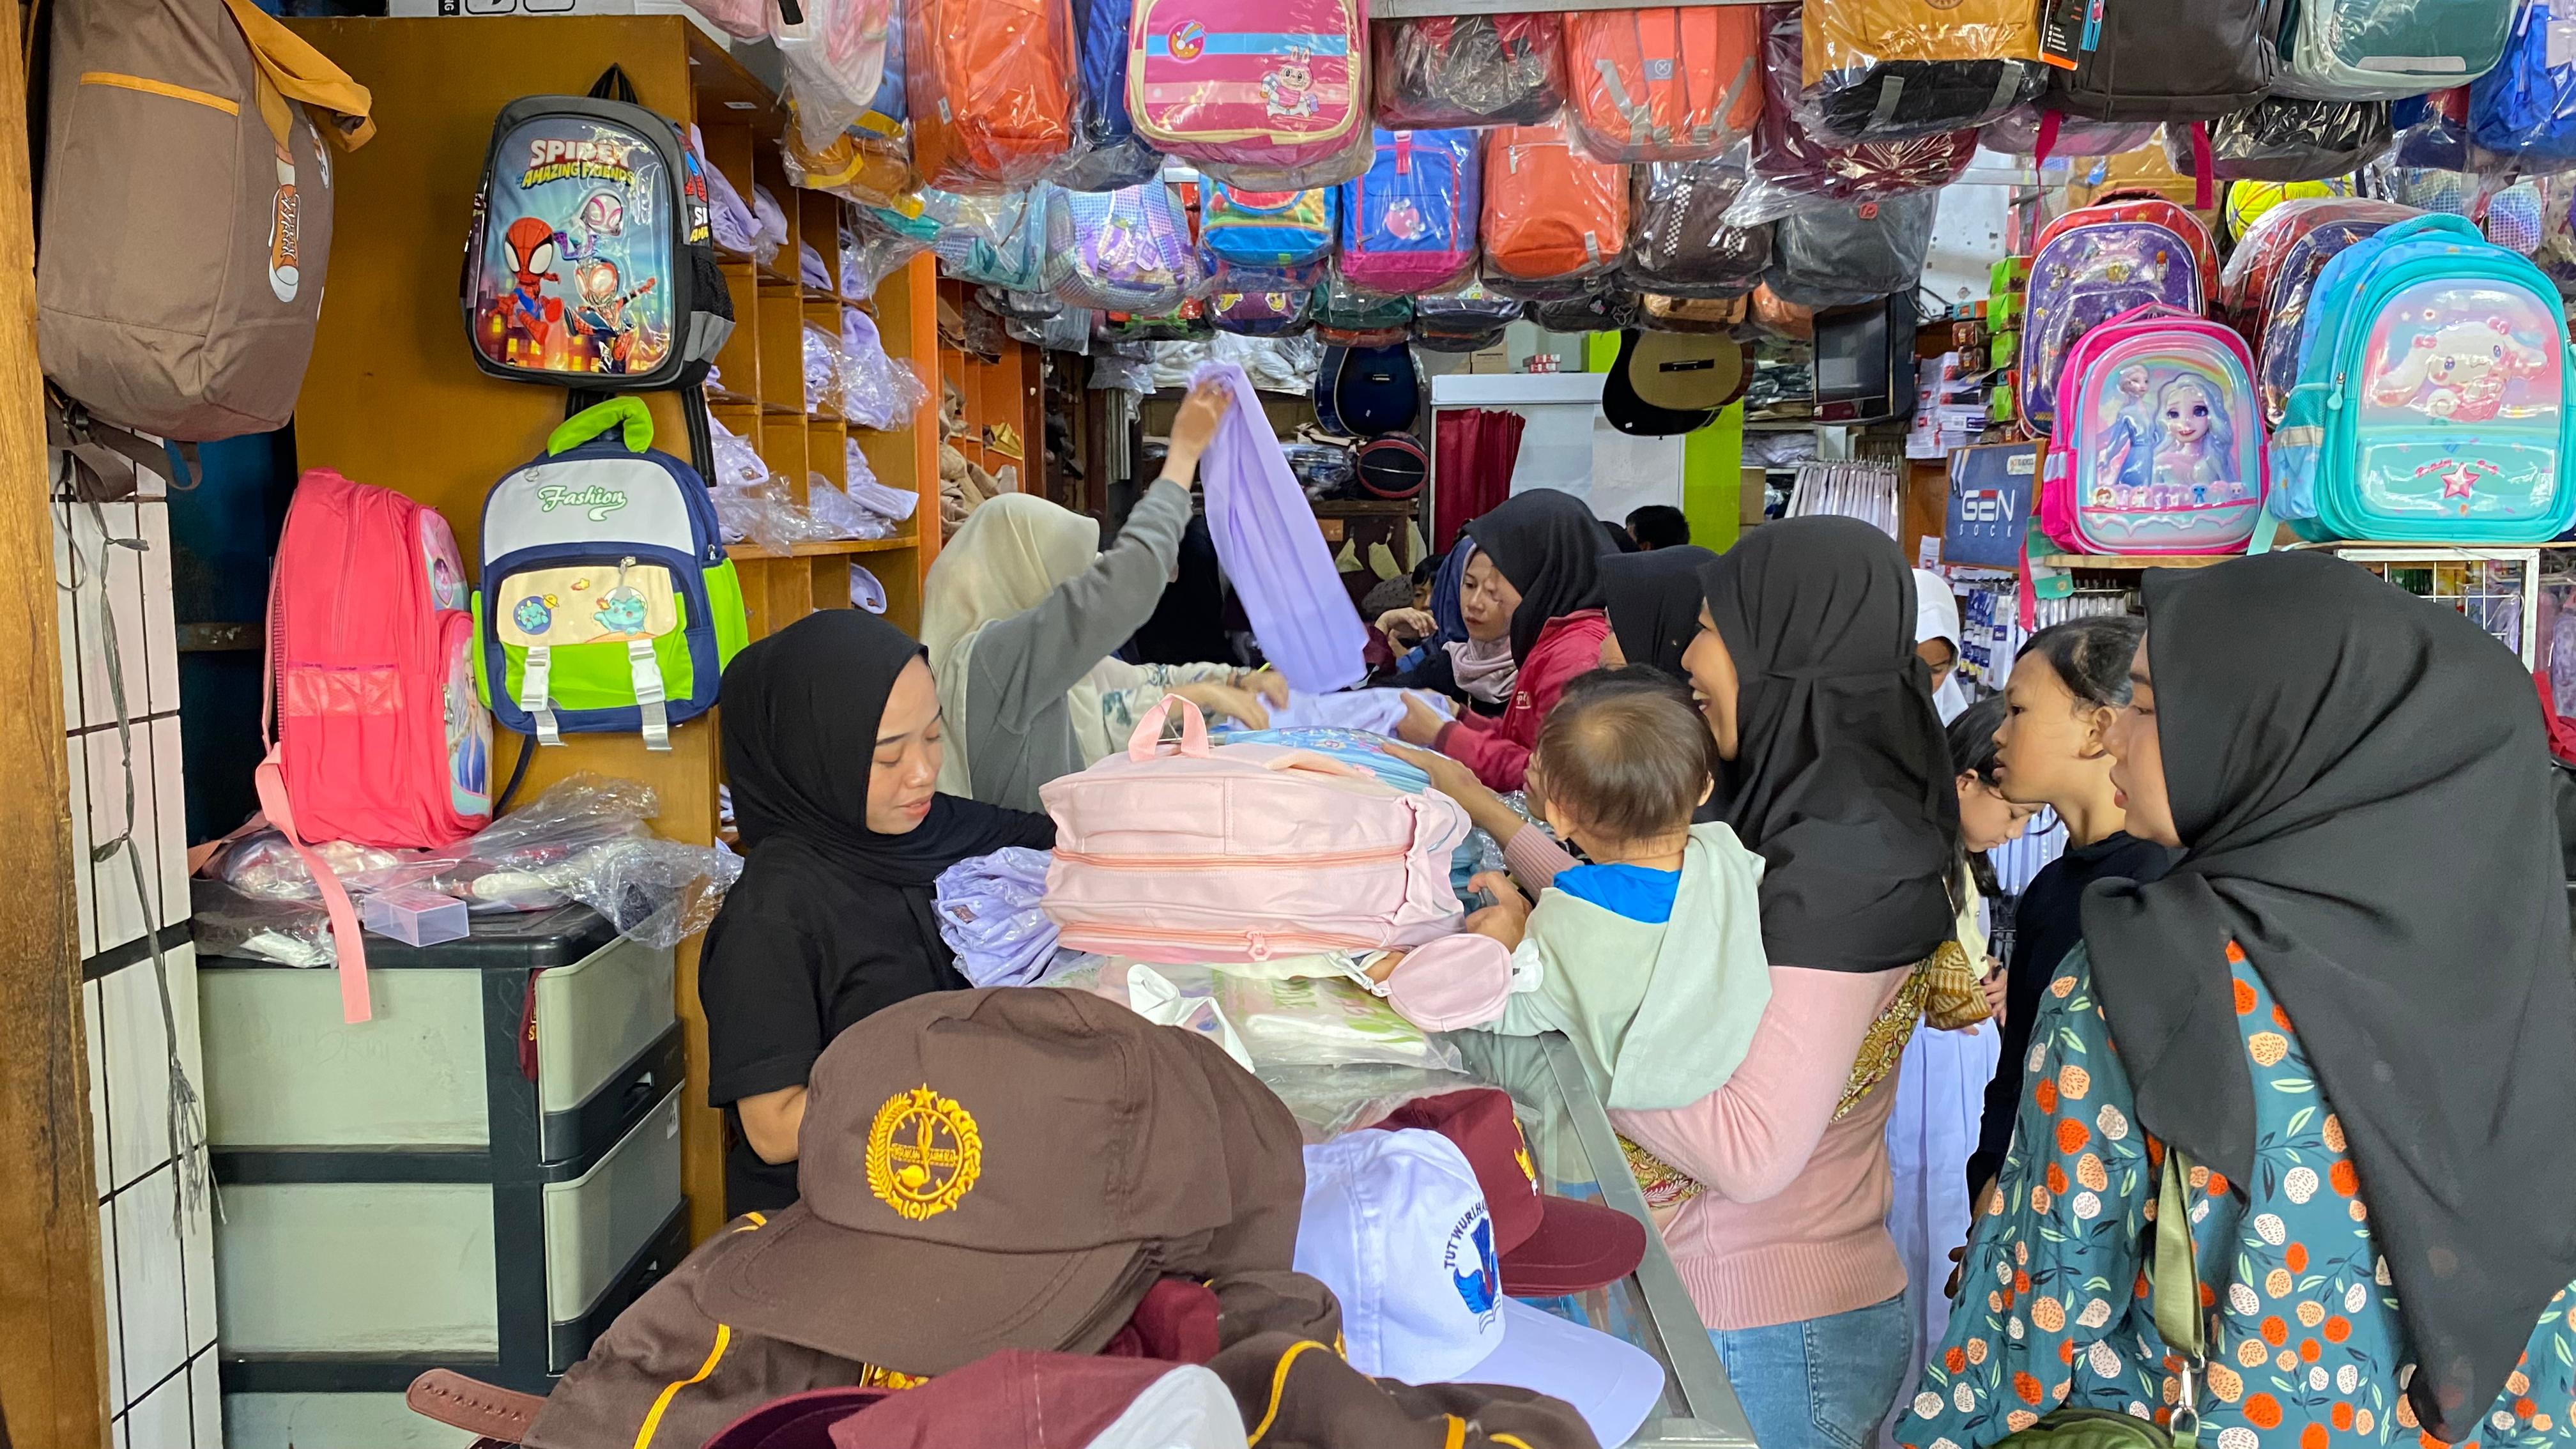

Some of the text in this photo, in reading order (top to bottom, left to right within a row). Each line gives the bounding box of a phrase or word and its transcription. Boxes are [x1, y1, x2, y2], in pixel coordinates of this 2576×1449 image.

[521, 162, 579, 189] AMAZING
[537, 485, 627, 521] Fashion
[1962, 489, 2015, 521] GEN
[1959, 524, 2012, 537] SOCK
[1444, 1240, 1459, 1269] TUT
